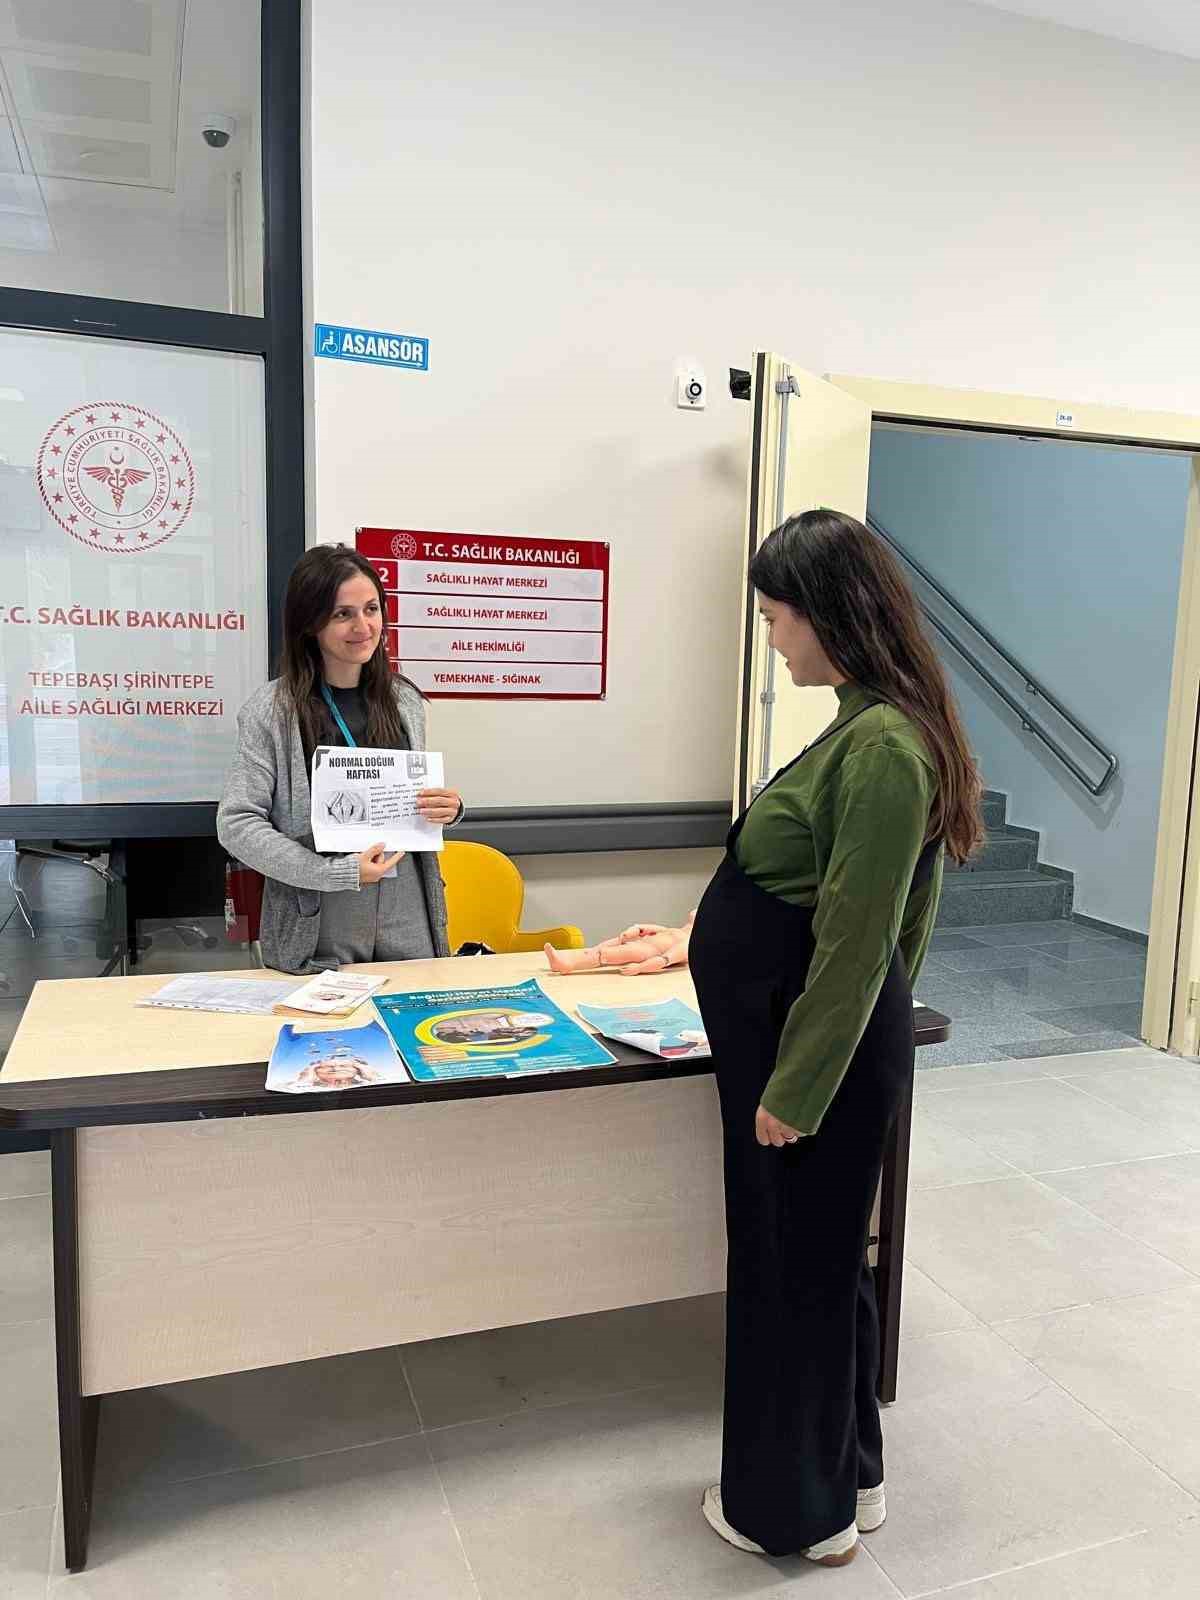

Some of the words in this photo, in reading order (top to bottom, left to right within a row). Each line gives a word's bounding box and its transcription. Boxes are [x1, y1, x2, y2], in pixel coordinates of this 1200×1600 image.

[342, 332, 424, 362] ASANSÖR
[423, 543, 448, 557] T.C.
[451, 543, 502, 560] SAĞLIK
[505, 547, 580, 565] BAKANLIĞI
[379, 568, 389, 582] 2
[426, 573, 470, 585] SAĞLIKLI
[473, 576, 504, 587] HAYAT
[506, 577, 548, 588] MERKEZİ
[38, 602, 120, 627] SAĞLIK
[126, 609, 245, 631] BAKANLIĞI
[427, 606, 471, 618] SAĞLIKLI
[473, 609, 504, 620] HAYAT
[506, 610, 548, 620] MERKEZİ
[451, 641, 473, 651] AİLE
[475, 641, 525, 652] HEKİMLİĞİ
[28, 671, 118, 691] TEPEBAŞI
[123, 671, 215, 691] ŞİRİNTEPE
[433, 674, 495, 684] YEMEKHANE
[502, 673, 541, 684] SIĞINAK
[20, 697, 61, 715] AİLE
[66, 697, 140, 715] SAĞLIĞI
[145, 698, 223, 716] MERKEZİ
[328, 757, 364, 768] NORMAL
[365, 755, 395, 767] DOĞUM
[346, 769, 380, 779] HAFTASI
